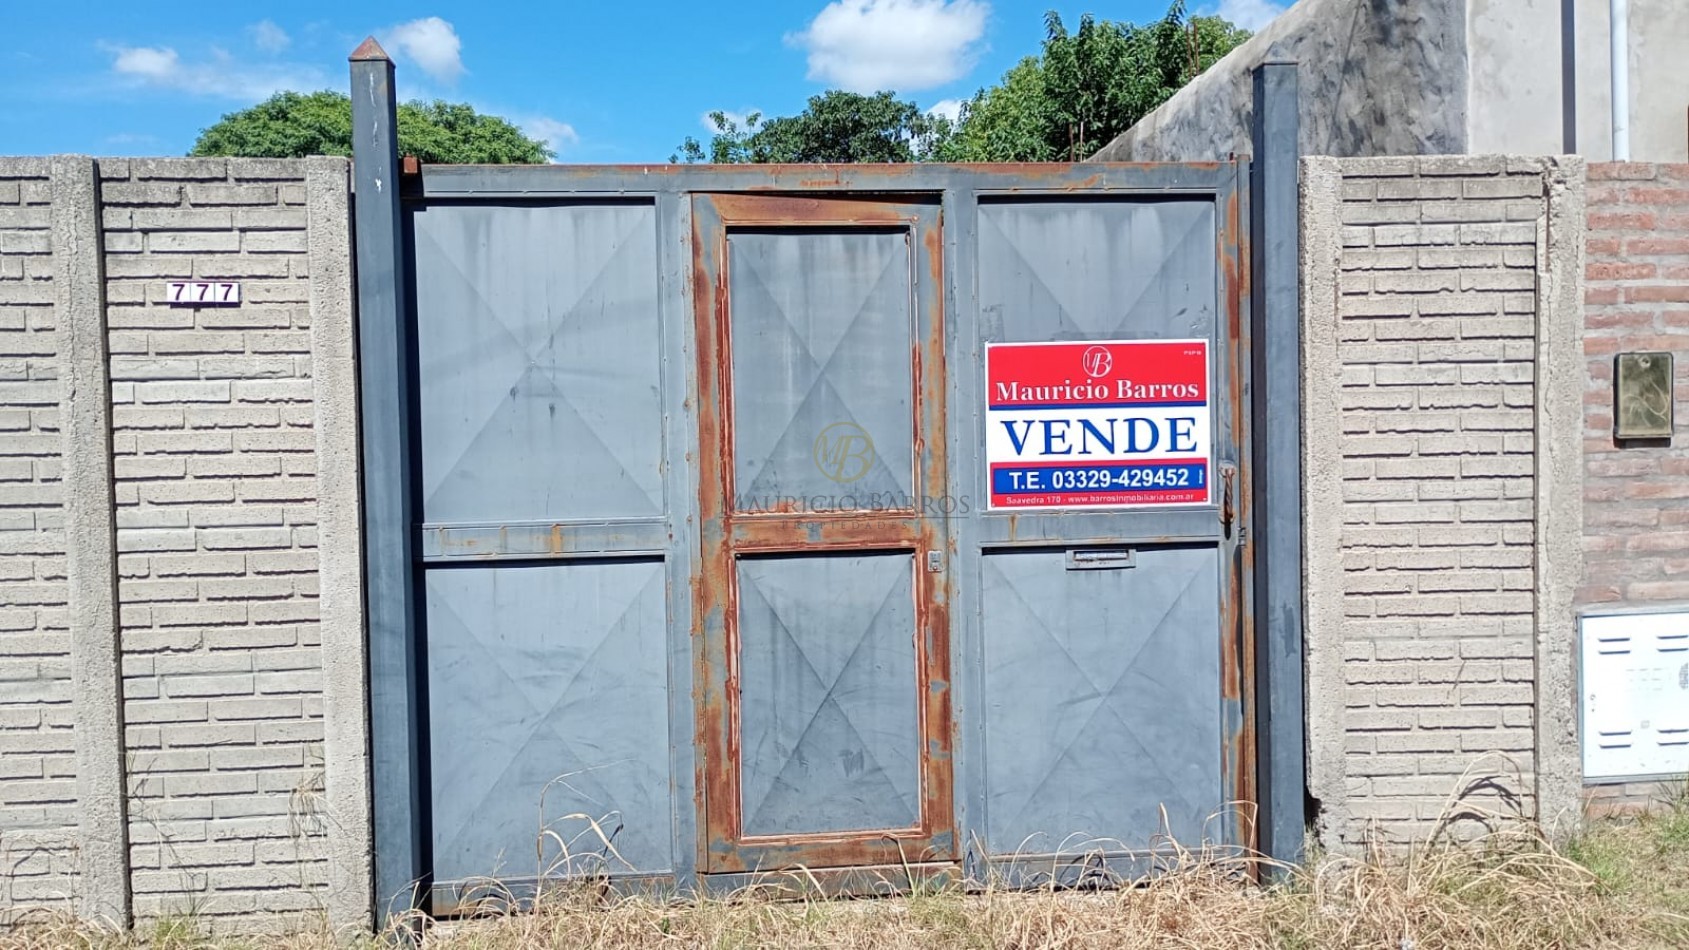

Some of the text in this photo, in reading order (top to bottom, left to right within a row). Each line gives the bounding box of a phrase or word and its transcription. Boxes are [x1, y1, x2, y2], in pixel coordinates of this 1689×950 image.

[172, 284, 233, 301] 777
[996, 379, 1199, 401] Mauricio Barros
[1000, 417, 1197, 455] VENDE
[1009, 472, 1046, 489] T.E.
[1052, 468, 1189, 489] 03329-429452
[1006, 496, 1045, 504] Saavedra
